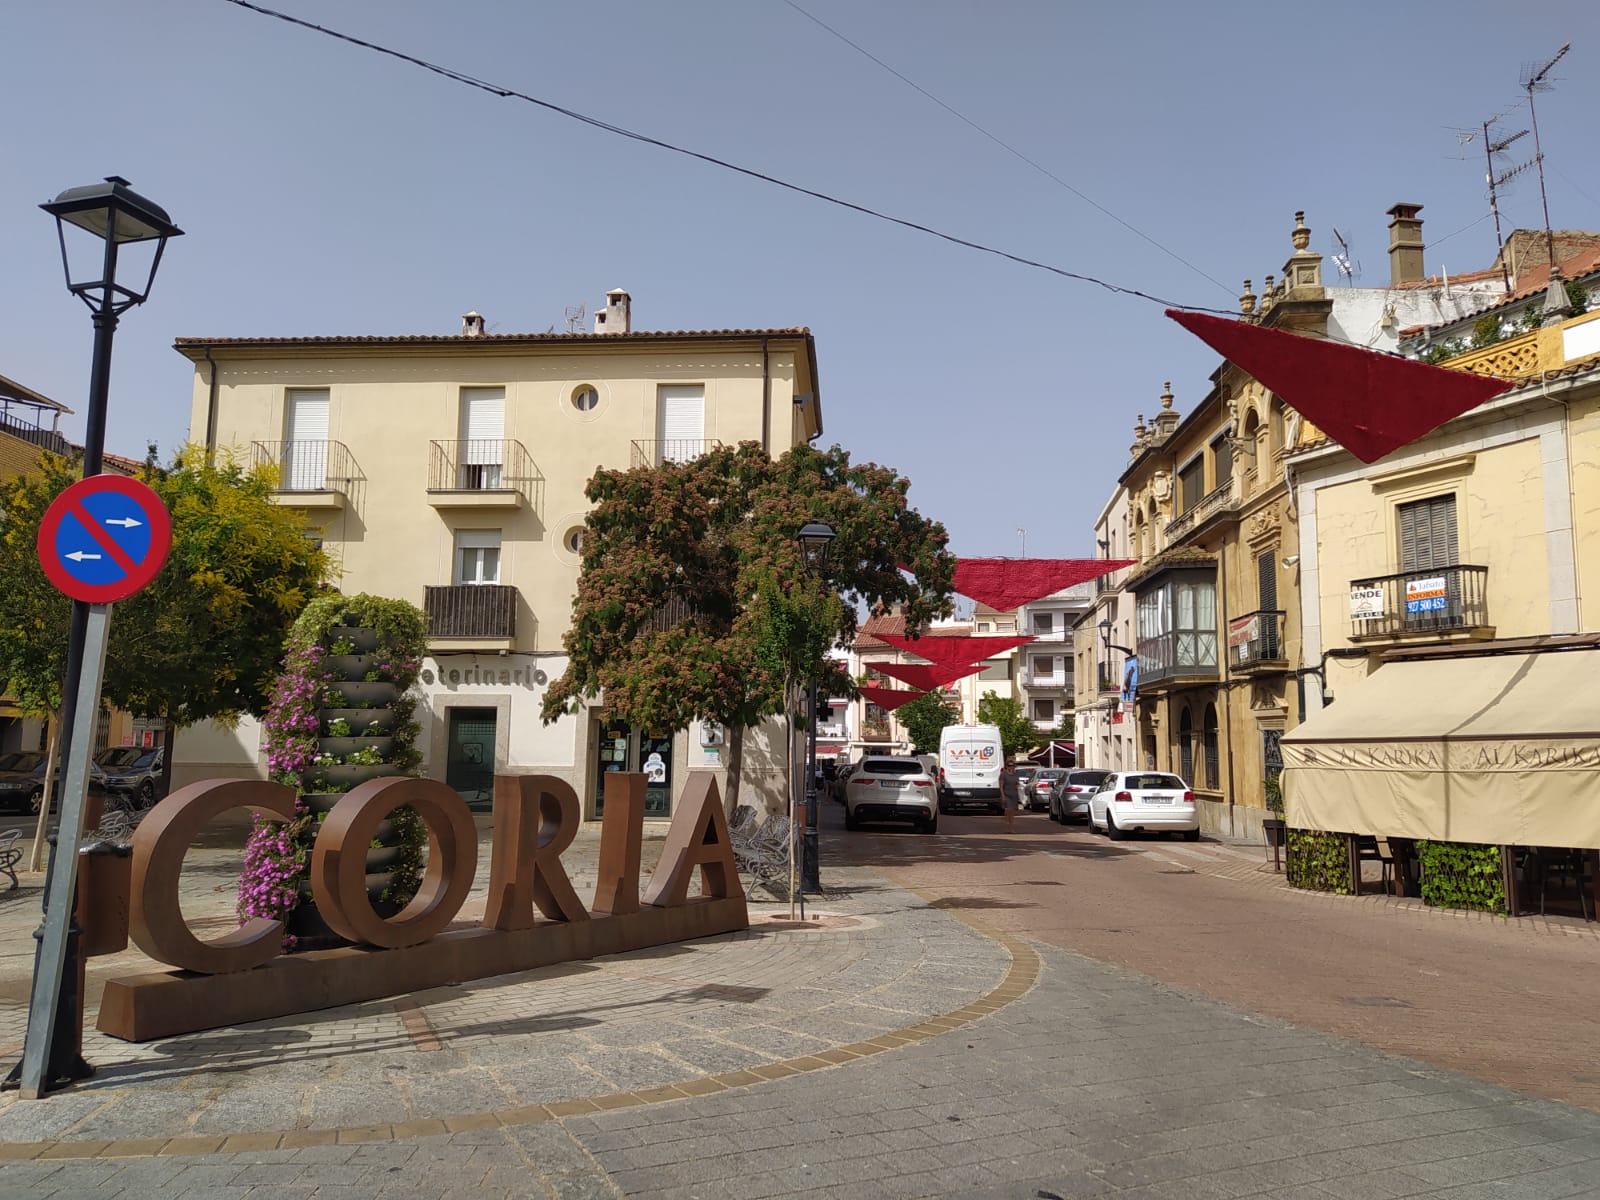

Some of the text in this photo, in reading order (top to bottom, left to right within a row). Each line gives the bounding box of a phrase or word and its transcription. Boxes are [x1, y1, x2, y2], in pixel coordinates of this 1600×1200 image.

[1351, 590, 1381, 600] VENDE
[1408, 590, 1445, 600] INFORMA
[421, 665, 547, 685] eterinario
[1477, 746, 1505, 765] AL
[128, 771, 744, 975] CORIA
